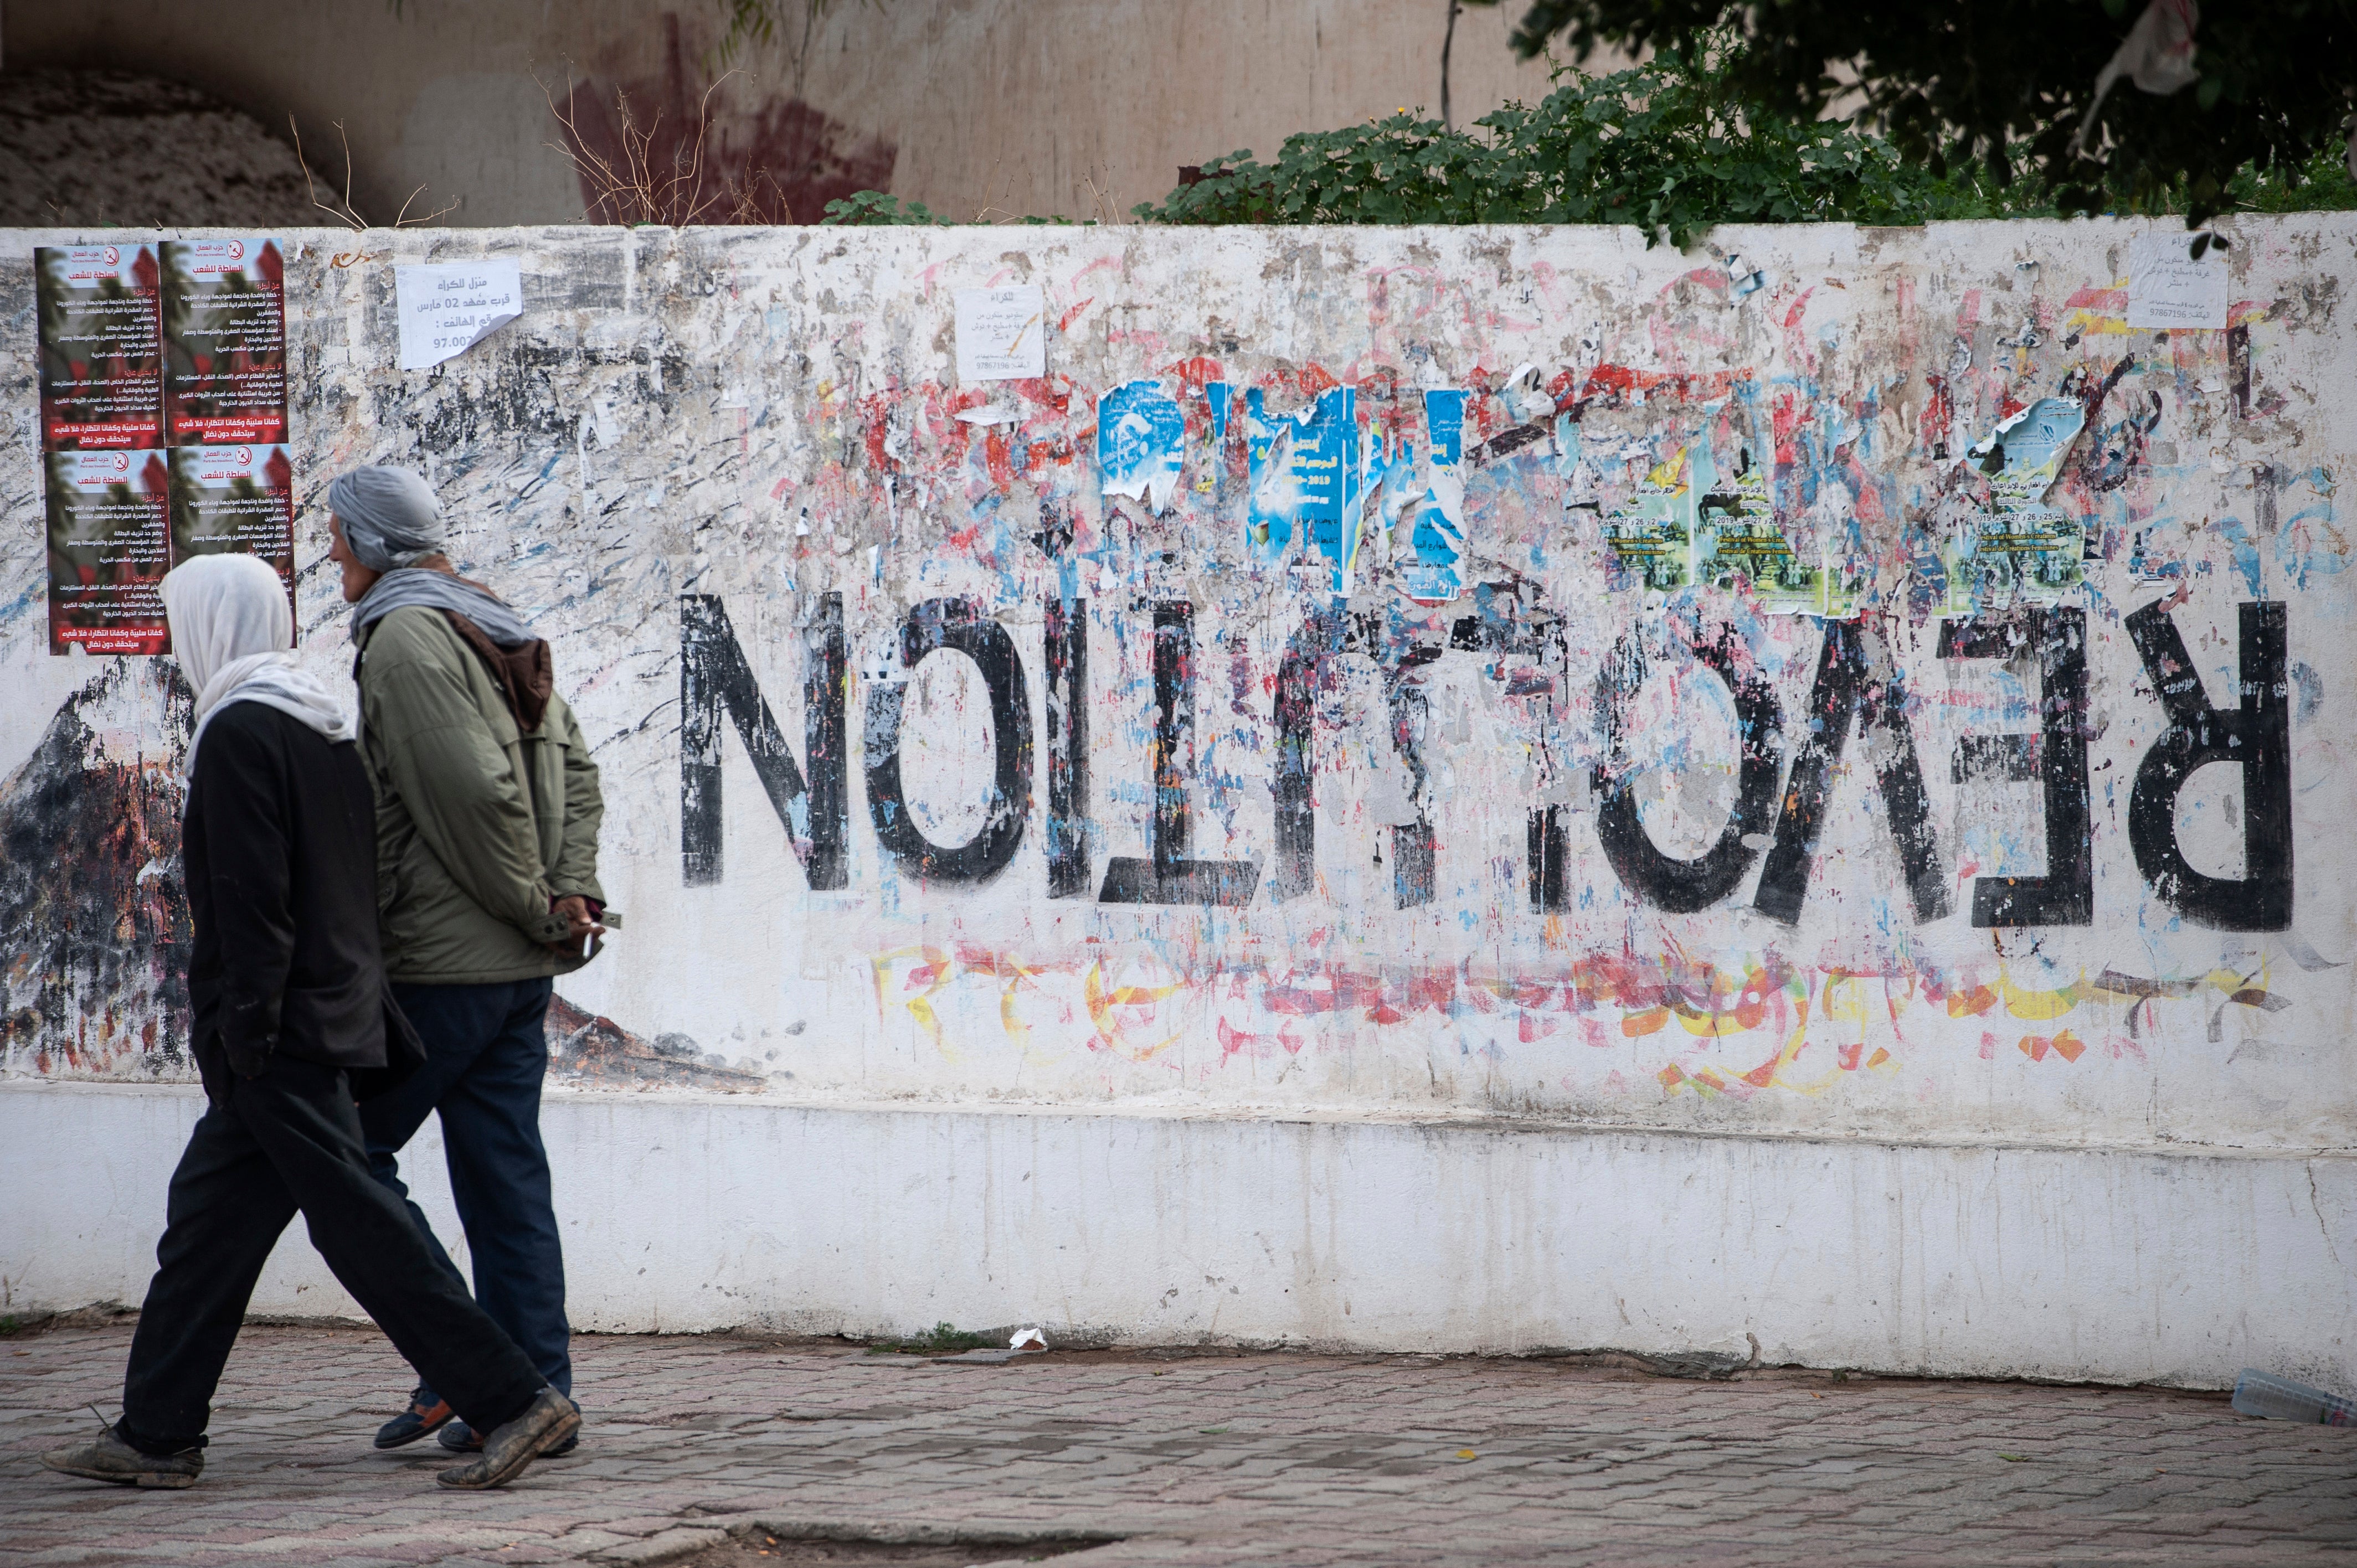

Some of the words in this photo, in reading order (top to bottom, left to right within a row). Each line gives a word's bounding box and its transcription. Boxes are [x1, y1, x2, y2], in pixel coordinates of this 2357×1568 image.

[193, 264, 215, 275] للشعب
[69, 270, 91, 281] للشعب
[438, 278, 464, 291] للكراء
[469, 277, 487, 289] منزل
[445, 298, 459, 308] 02
[491, 293, 510, 306] قرب
[990, 292, 1013, 303] للكراء
[418, 299, 441, 312] مارس
[2150, 308, 2186, 318] 97867196
[479, 314, 492, 327] قم
[178, 420, 194, 429] شيء
[78, 476, 100, 486] للشعب
[103, 476, 128, 484] السلطة
[201, 470, 224, 481] للشعب
